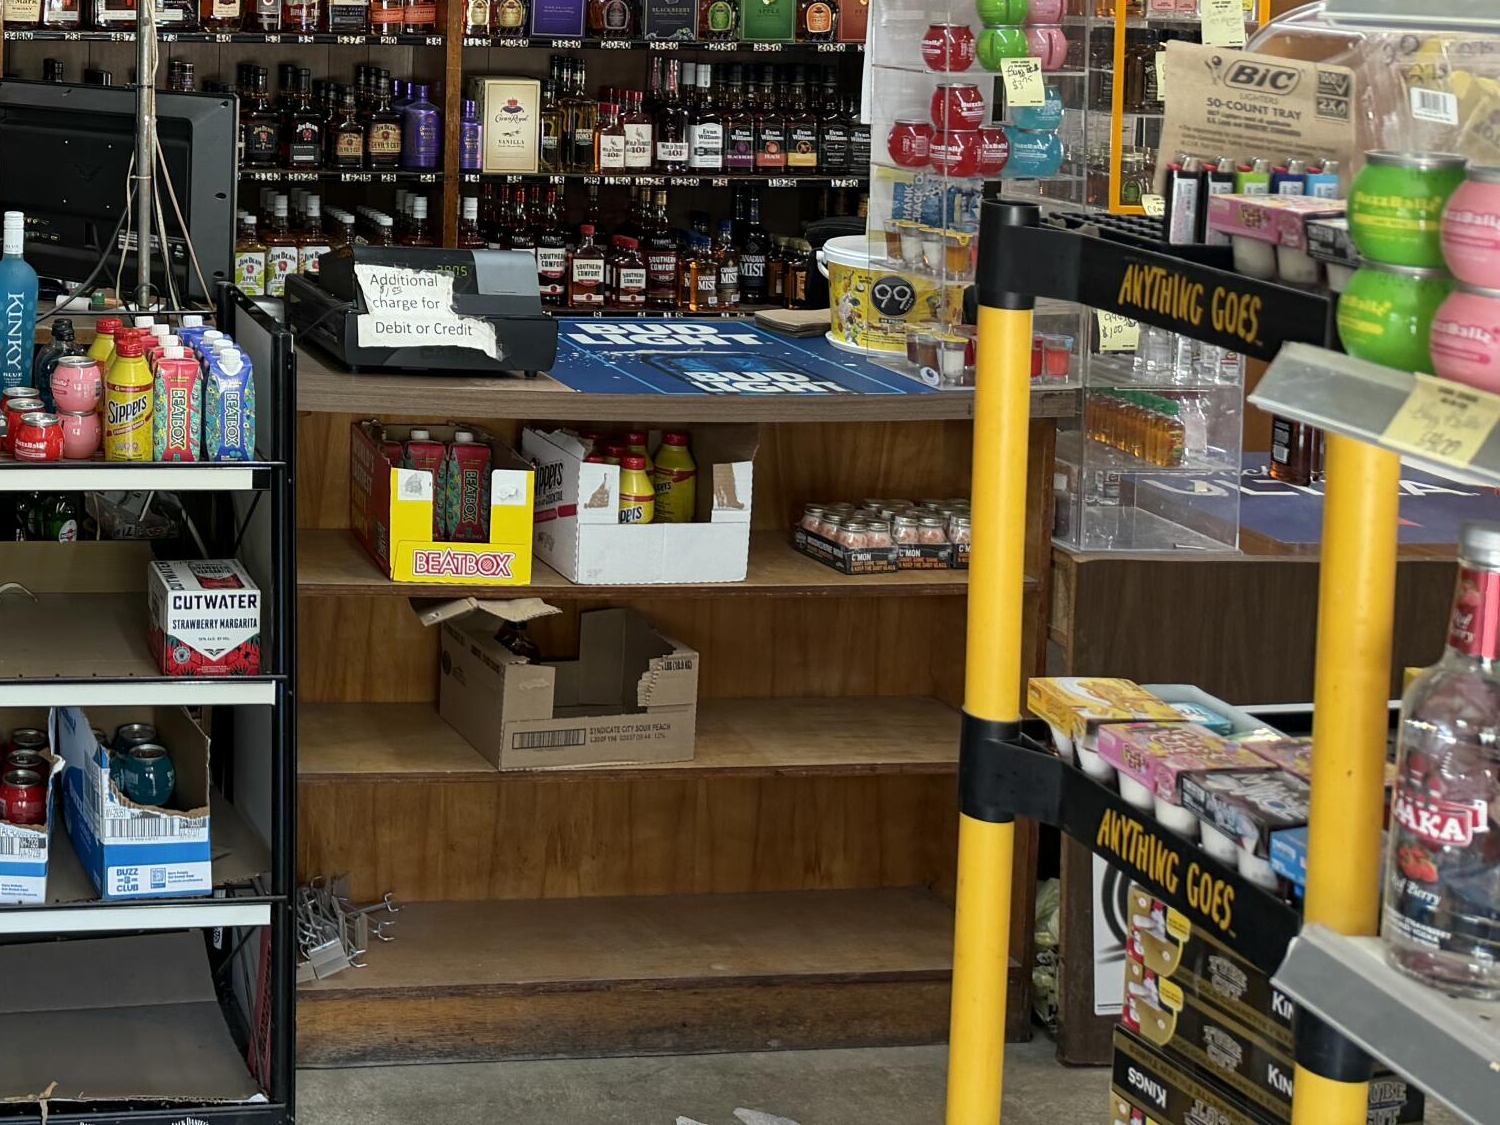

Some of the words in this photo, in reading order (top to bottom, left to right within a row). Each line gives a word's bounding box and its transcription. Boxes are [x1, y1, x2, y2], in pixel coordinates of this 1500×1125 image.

[381, 36, 397, 45] 20
[709, 42, 737, 51] 2050
[817, 43, 846, 52] 2050
[1239, 92, 1279, 106] LIGHTERS
[1206, 97, 1269, 115] 50-COUNT
[1272, 107, 1302, 121] TRAY
[702, 127, 718, 135] Evan
[764, 128, 780, 136] Evan
[584, 176, 600, 185] 29
[238, 258, 247, 268] JIM
[247, 258, 262, 268] BEAM
[268, 251, 280, 263] JIM
[280, 251, 296, 263] BEAM
[576, 262, 602, 270] SOUTHERN
[577, 269, 601, 277] COMFORT
[739, 263, 766, 277] MIST
[369, 273, 438, 288] Additional
[372, 296, 419, 311] charge
[421, 297, 440, 309] for
[873, 283, 912, 311] 99
[1118, 263, 1205, 326] ANYTHING
[1211, 285, 1264, 343] GOES
[6, 291, 25, 374] KINKY
[375, 321, 412, 335] Debit
[415, 325, 431, 335] or
[433, 323, 473, 337] Credit
[575, 322, 720, 335] BUD
[567, 333, 765, 346] LIGHT
[682, 370, 811, 384] BUD
[691, 380, 848, 393] LIGHT
[107, 394, 149, 423] Sippers
[169, 386, 187, 449] BEATBOX
[224, 390, 240, 447] BEATBOX
[462, 469, 478, 524] BEATBOX
[851, 552, 872, 562] C'MON
[899, 549, 921, 557] C'MON
[413, 548, 516, 578] BEATBOX
[172, 593, 258, 611] CUTWATER
[172, 616, 218, 631] STRAWBERRY
[218, 616, 258, 630] MARGARITA
[589, 725, 621, 735] SYNDICATE
[621, 725, 634, 733] CITY
[635, 724, 651, 732] SOUR
[652, 723, 671, 731] PEACH
[116, 867, 139, 876] BUZZ
[1096, 806, 1181, 896] ANYTHING
[1186, 860, 1236, 931] GOES
[116, 884, 139, 892] CLUB
[1127, 1066, 1168, 1112] KINGS
